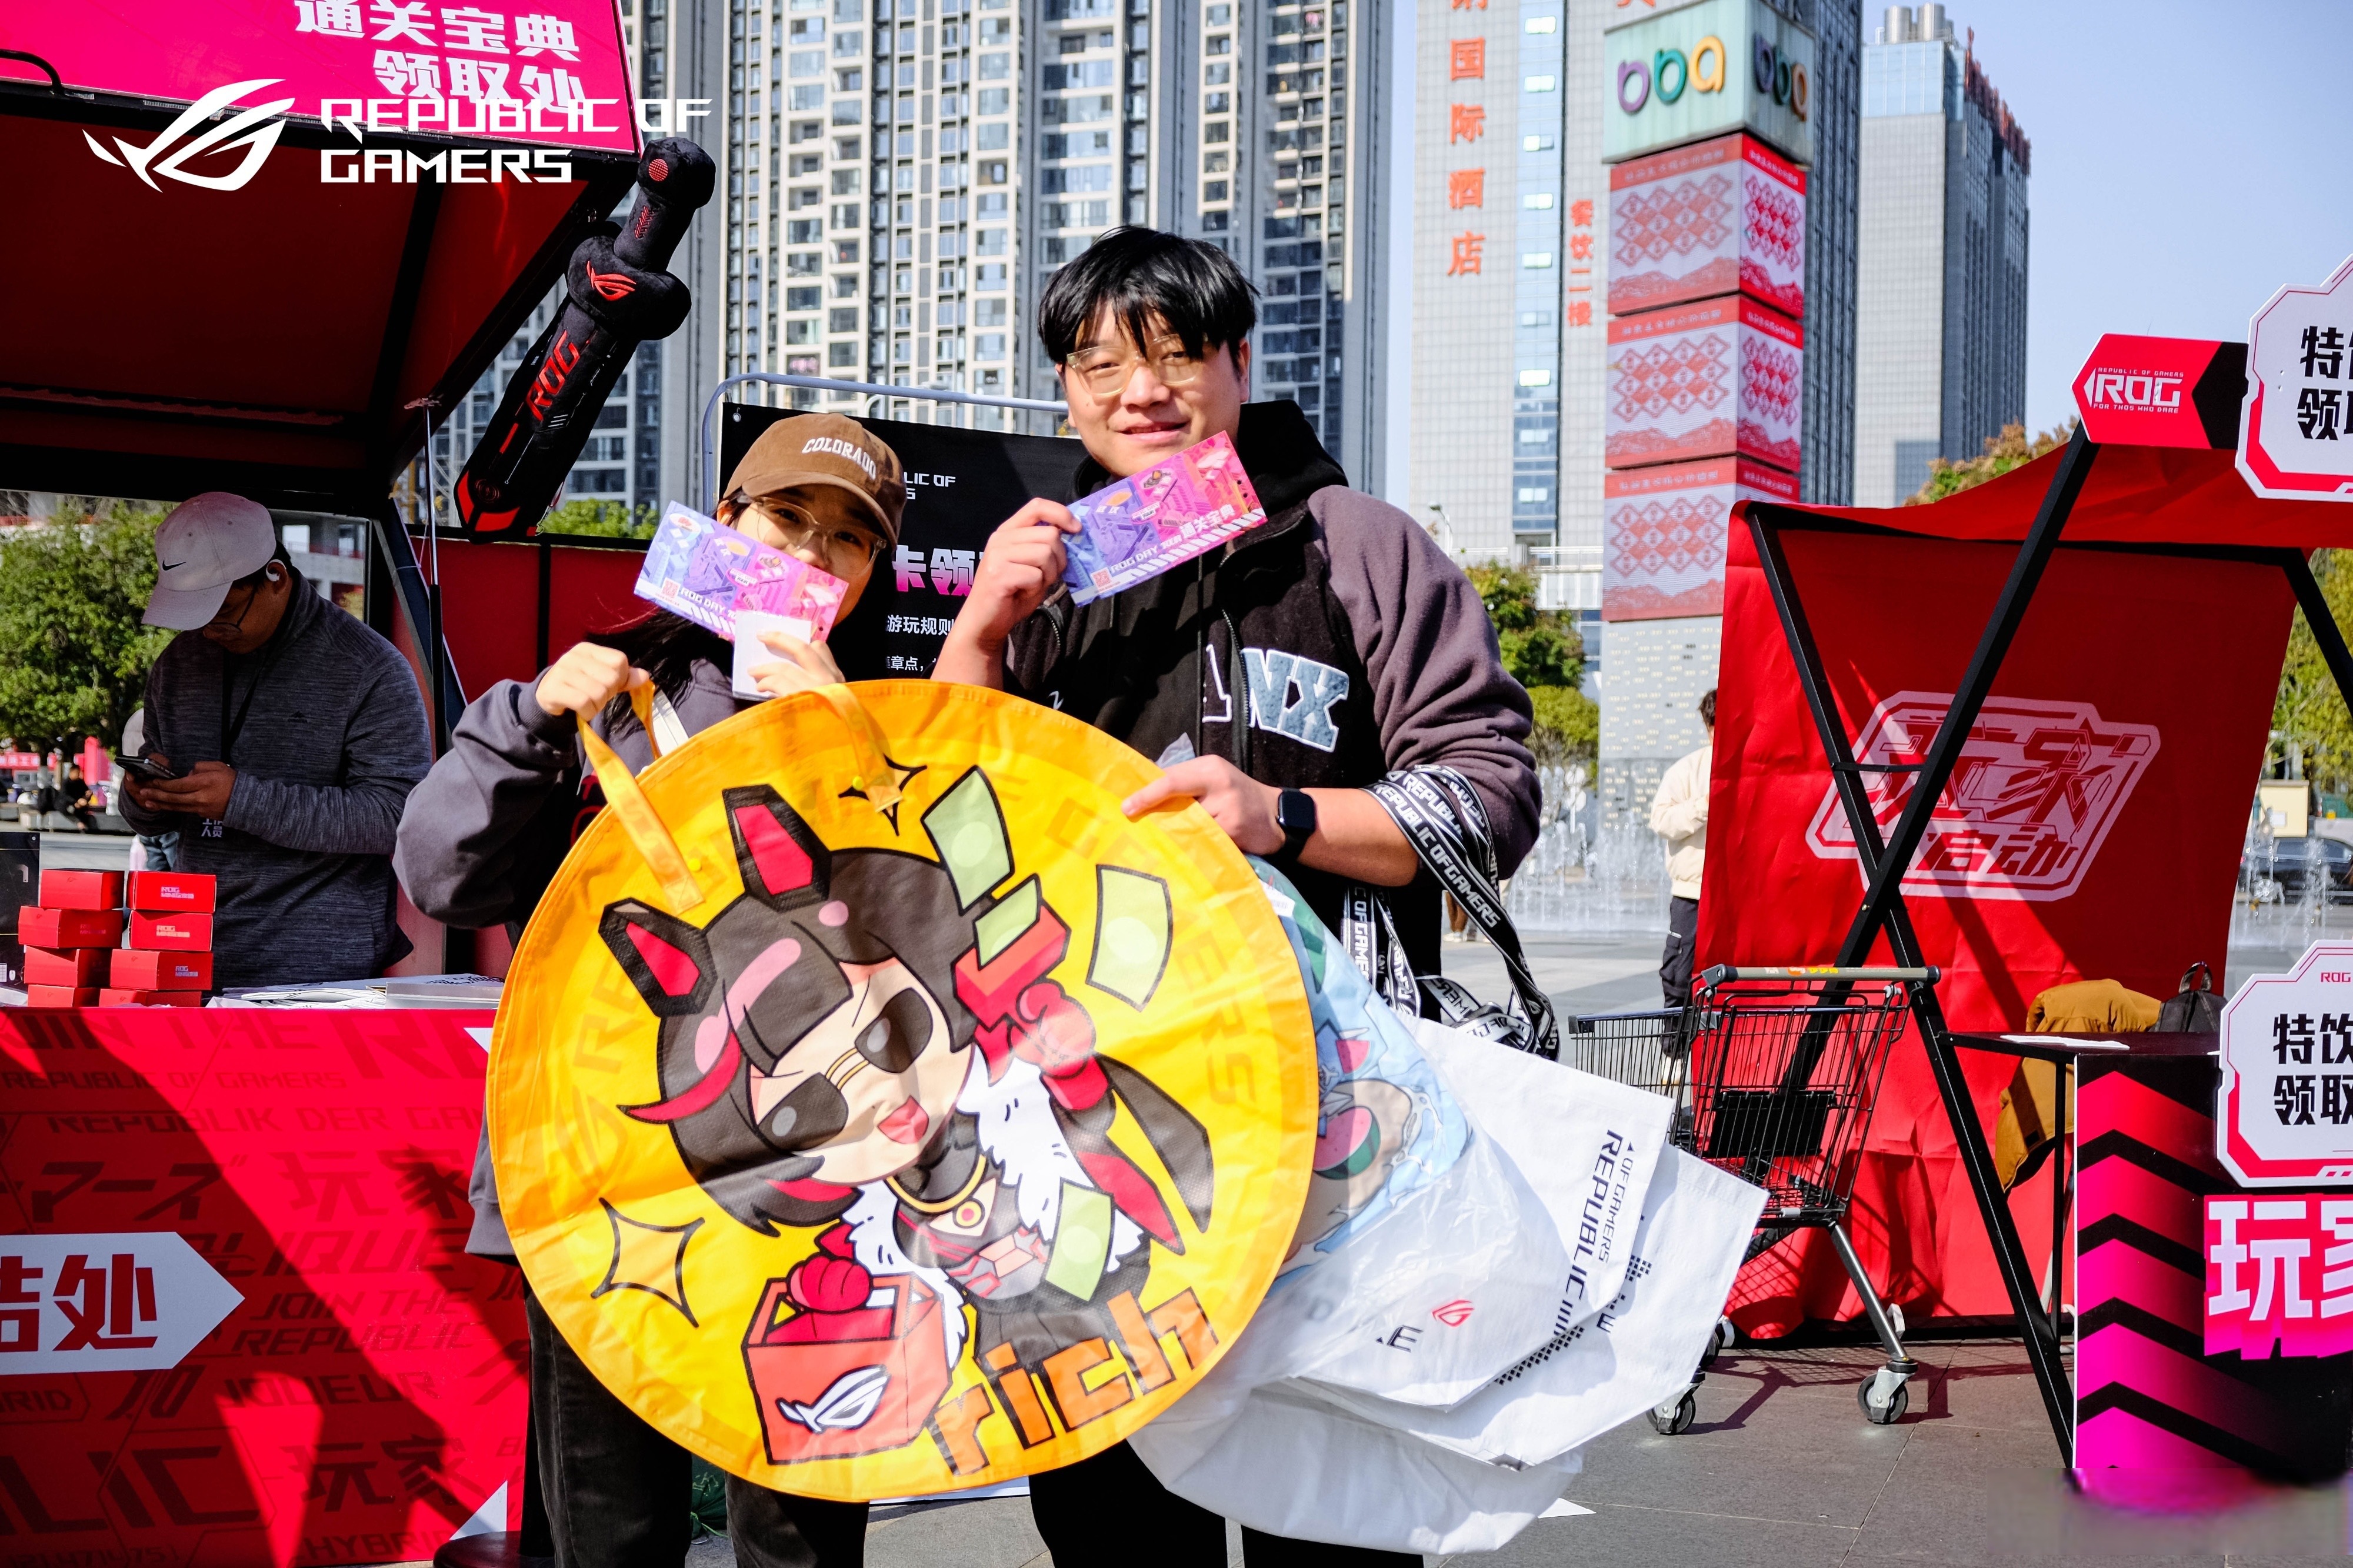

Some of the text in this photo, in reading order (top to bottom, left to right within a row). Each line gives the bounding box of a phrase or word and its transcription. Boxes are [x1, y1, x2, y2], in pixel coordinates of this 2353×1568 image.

[296, 0, 581, 61] 通关宝典
[373, 49, 584, 115] 领取处
[526, 329, 581, 421] ROG
[2299, 325, 2353, 379] 特
[2094, 373, 2183, 407] ROG
[2297, 388, 2353, 441] 领
[802, 437, 876, 480] COLORADO
[933, 474, 956, 487] OF
[1111, 556, 1135, 573] ROG
[1136, 545, 1159, 562] DAY
[1179, 503, 1235, 540] 通关宝典
[892, 545, 984, 596] 卡领
[680, 587, 702, 605] ROG
[702, 597, 727, 613] DAY
[201, 826, 222, 838] 人员
[1375, 784, 1437, 848] REPUBLIC
[1429, 843, 1453, 865] OF
[1444, 866, 1501, 928] GAMERS
[1354, 900, 1368, 923] OF
[1354, 922, 1370, 980] GAME
[2321, 972, 2351, 983] ROG
[2, 1072, 158, 1089] REPUBLIC
[215, 1072, 348, 1089] GAMERS
[47, 1107, 284, 1134] REPUBLIK
[294, 1106, 392, 1132] DER
[1565, 1129, 1624, 1300] REPUBLIC
[1598, 1157, 1634, 1265] OF GAMERS
[249, 1287, 474, 1321] JOIN THE
[231, 1320, 484, 1357] REPUBLIC
[934, 1286, 1219, 1477] rich
